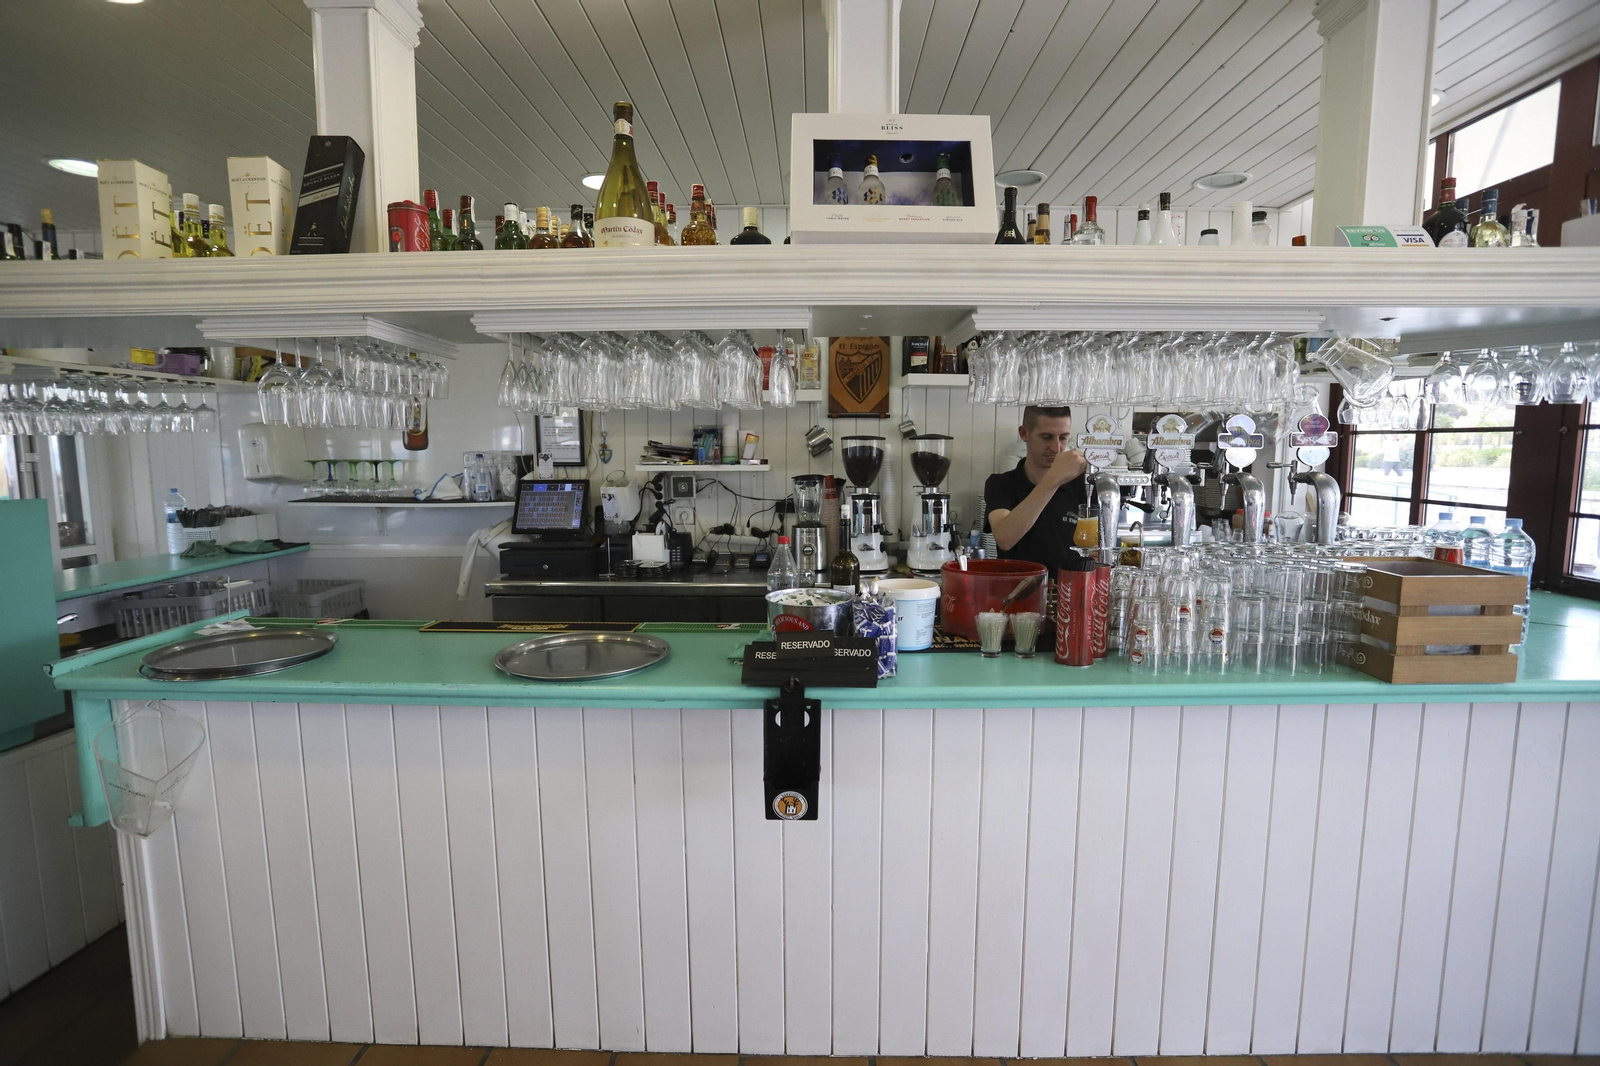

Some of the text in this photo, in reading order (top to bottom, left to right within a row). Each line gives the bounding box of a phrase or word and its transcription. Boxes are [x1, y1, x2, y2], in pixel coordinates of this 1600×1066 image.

[850, 343, 880, 351] Espigón
[1081, 436, 1122, 447] Alhambra
[1151, 436, 1192, 447] Alhambra
[1088, 451, 1111, 461] Especial
[799, 621, 809, 631] AND
[781, 640, 830, 650] RESERVADO
[755, 651, 777, 659] RESE
